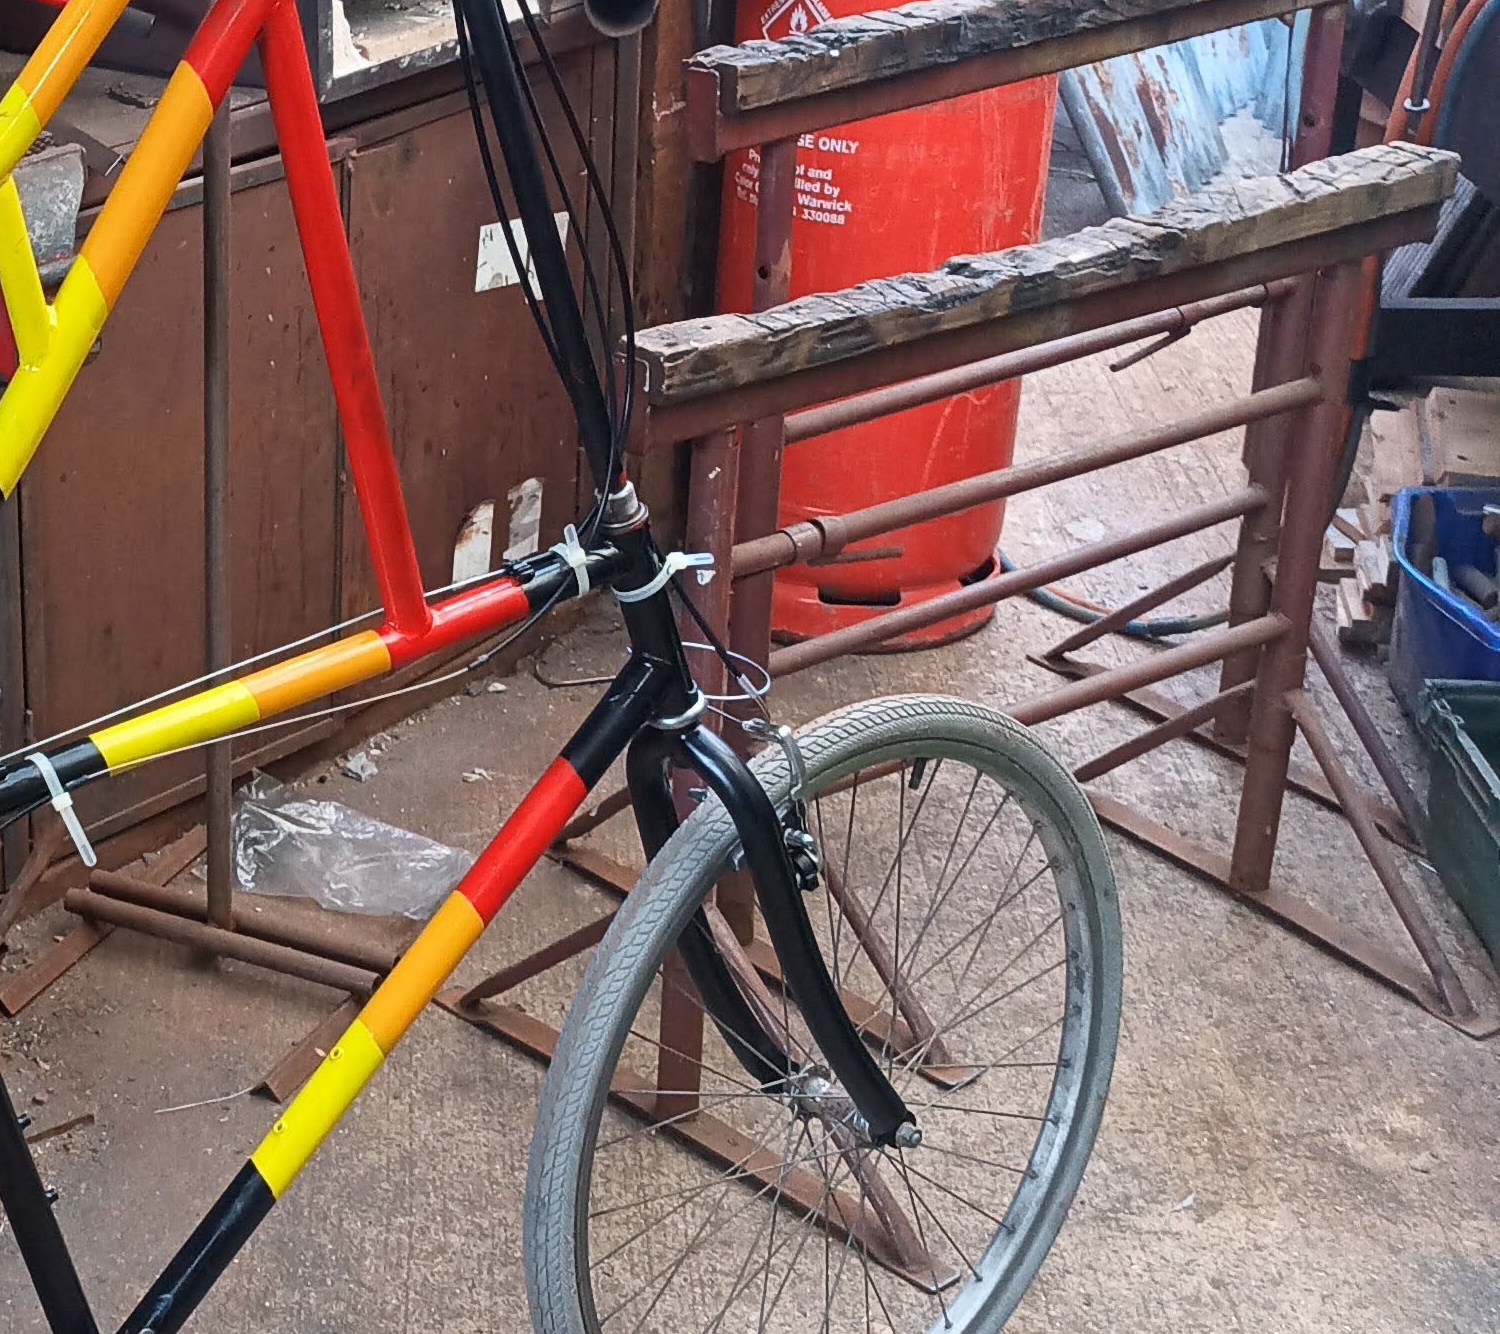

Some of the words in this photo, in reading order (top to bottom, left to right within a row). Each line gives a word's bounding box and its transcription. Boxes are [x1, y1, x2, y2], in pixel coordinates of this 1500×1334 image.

[818, 136, 860, 155] ONLY
[807, 168, 833, 181] and
[824, 183, 840, 198] by
[797, 192, 853, 213] Warwick
[801, 208, 846, 225] 330088
